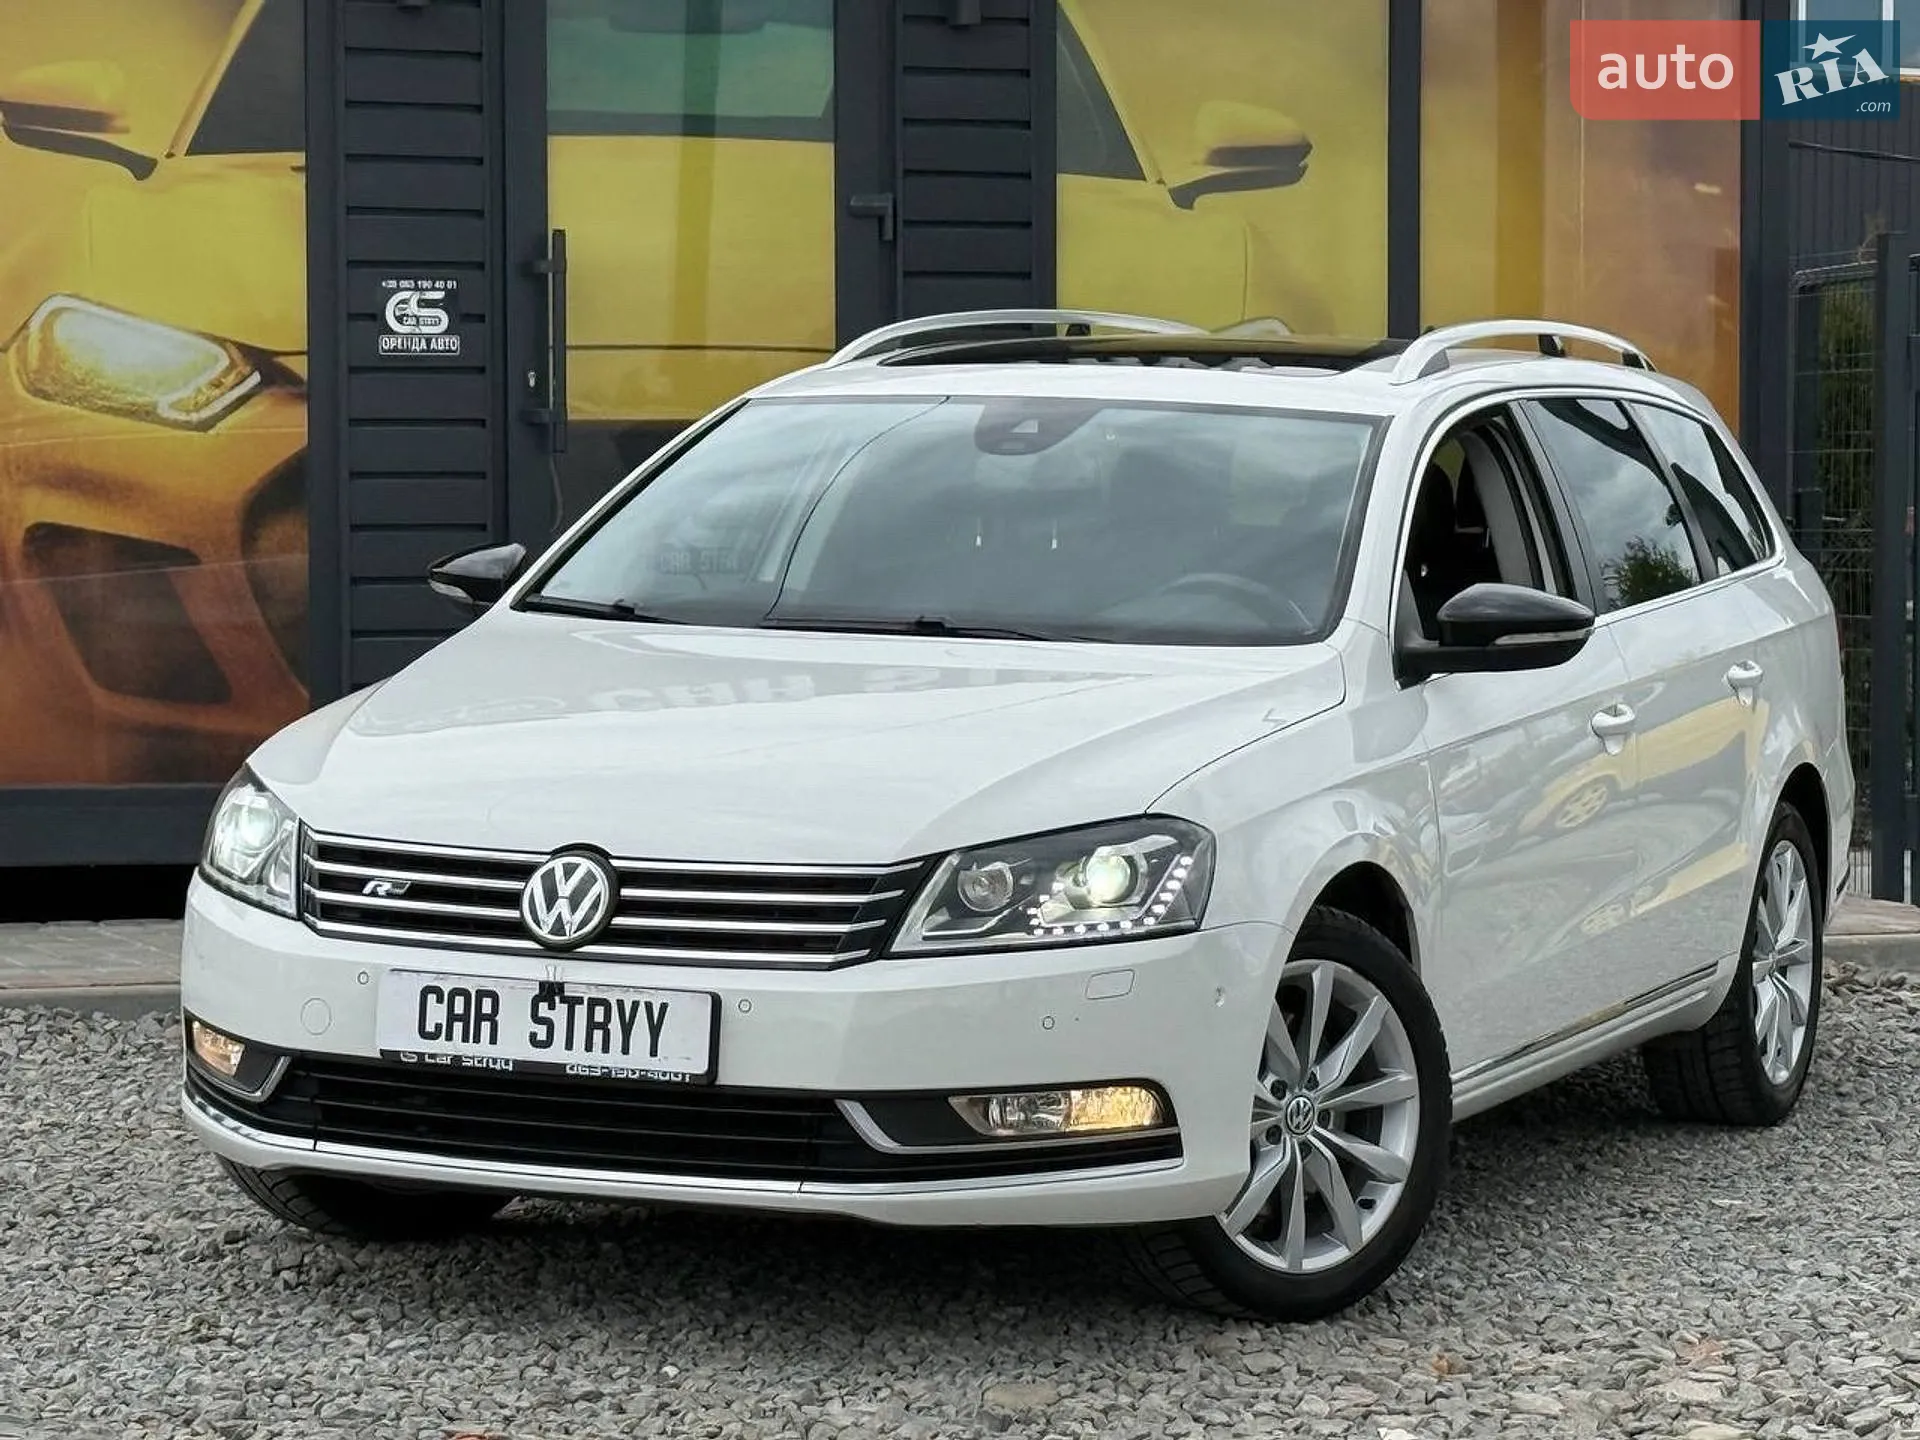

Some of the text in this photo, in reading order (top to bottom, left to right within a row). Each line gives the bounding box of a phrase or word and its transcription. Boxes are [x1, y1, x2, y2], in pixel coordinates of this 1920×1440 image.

[434, 280, 445, 289] 40
[446, 280, 457, 289] 01
[382, 338, 458, 352] ОРЕНДА АВТО
[418, 985, 669, 1057] CAR STRYY
